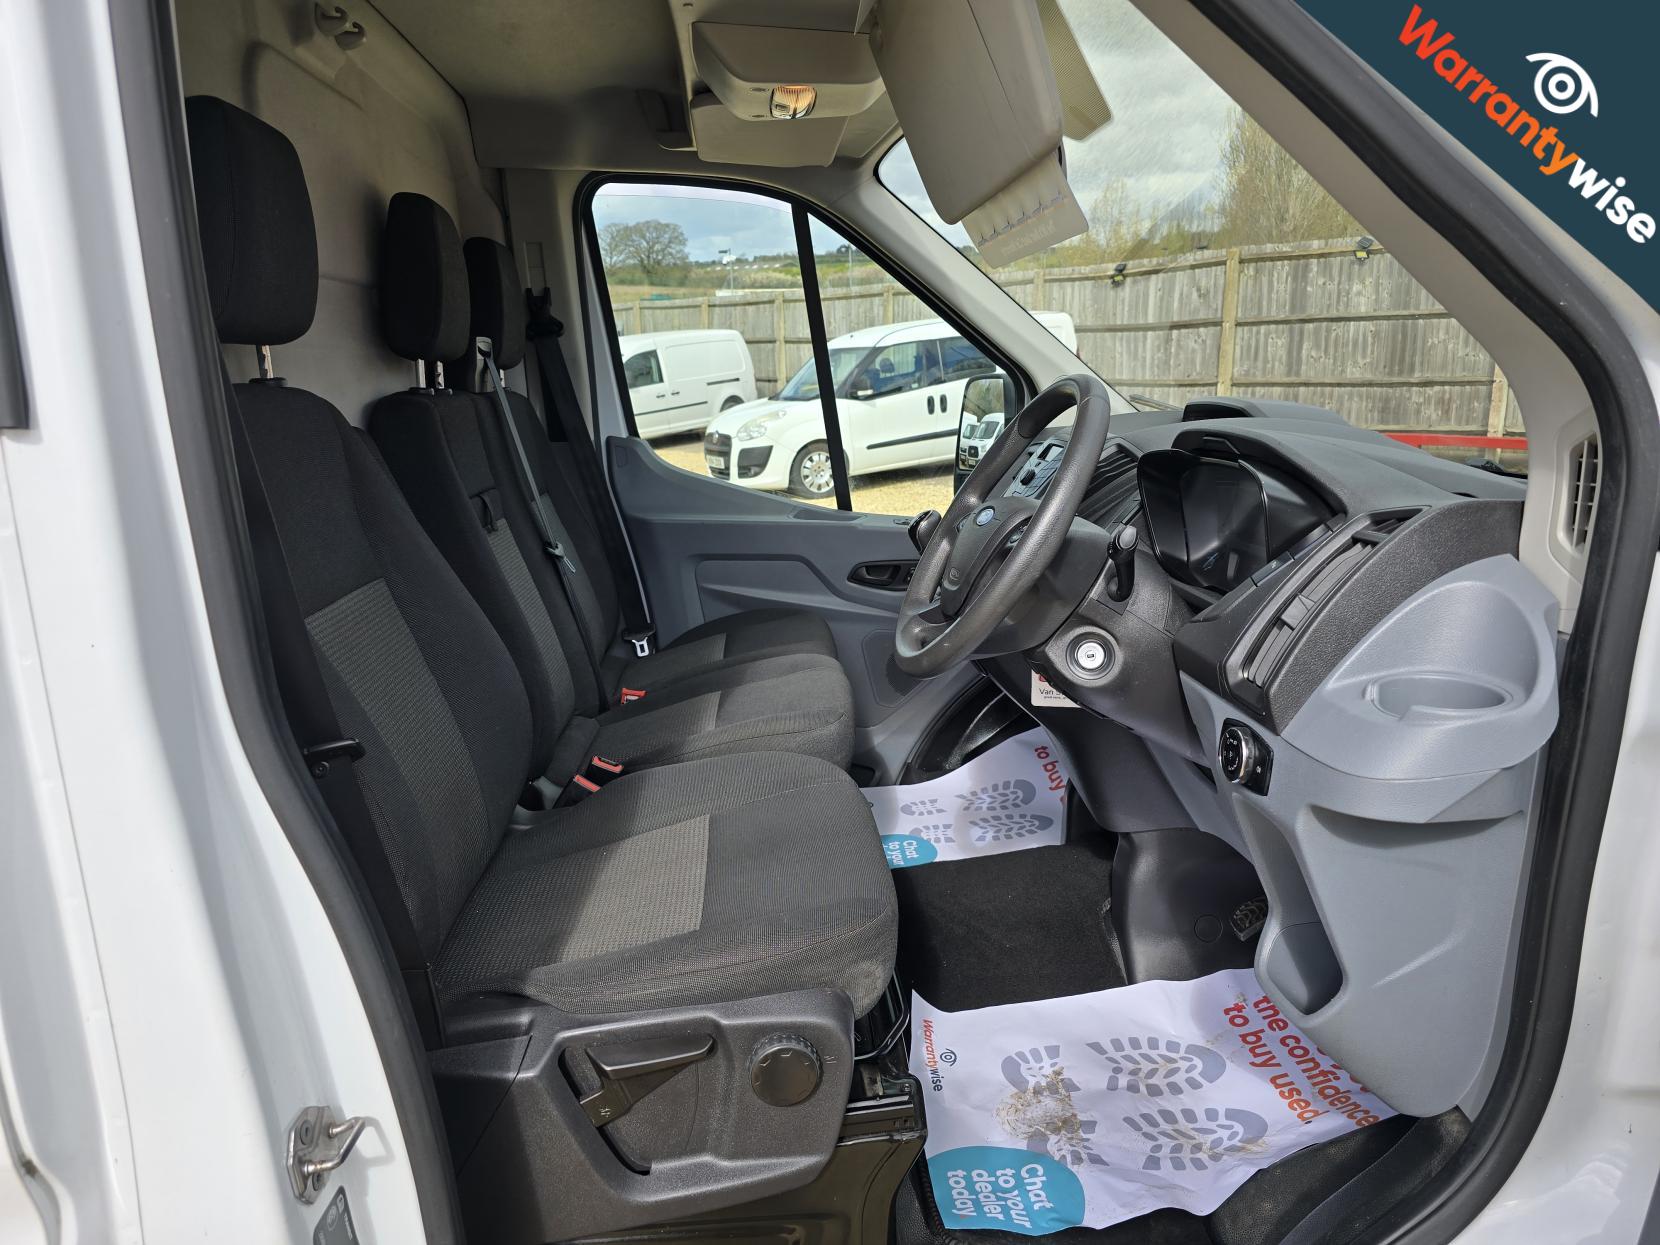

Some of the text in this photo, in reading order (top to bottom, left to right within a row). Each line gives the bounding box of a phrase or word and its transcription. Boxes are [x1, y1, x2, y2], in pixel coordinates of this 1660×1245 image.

[1034, 745, 1066, 791] to buy
[903, 840, 919, 859] Chat
[922, 1017, 945, 1092] Warrantywise
[1223, 1002, 1330, 1125] to buy used.
[1253, 995, 1289, 1032] the
[1279, 1034, 1380, 1127] confidence
[971, 1169, 1006, 1221] dealer
[996, 1167, 1032, 1229] to your
[1021, 1163, 1054, 1211] Chat
